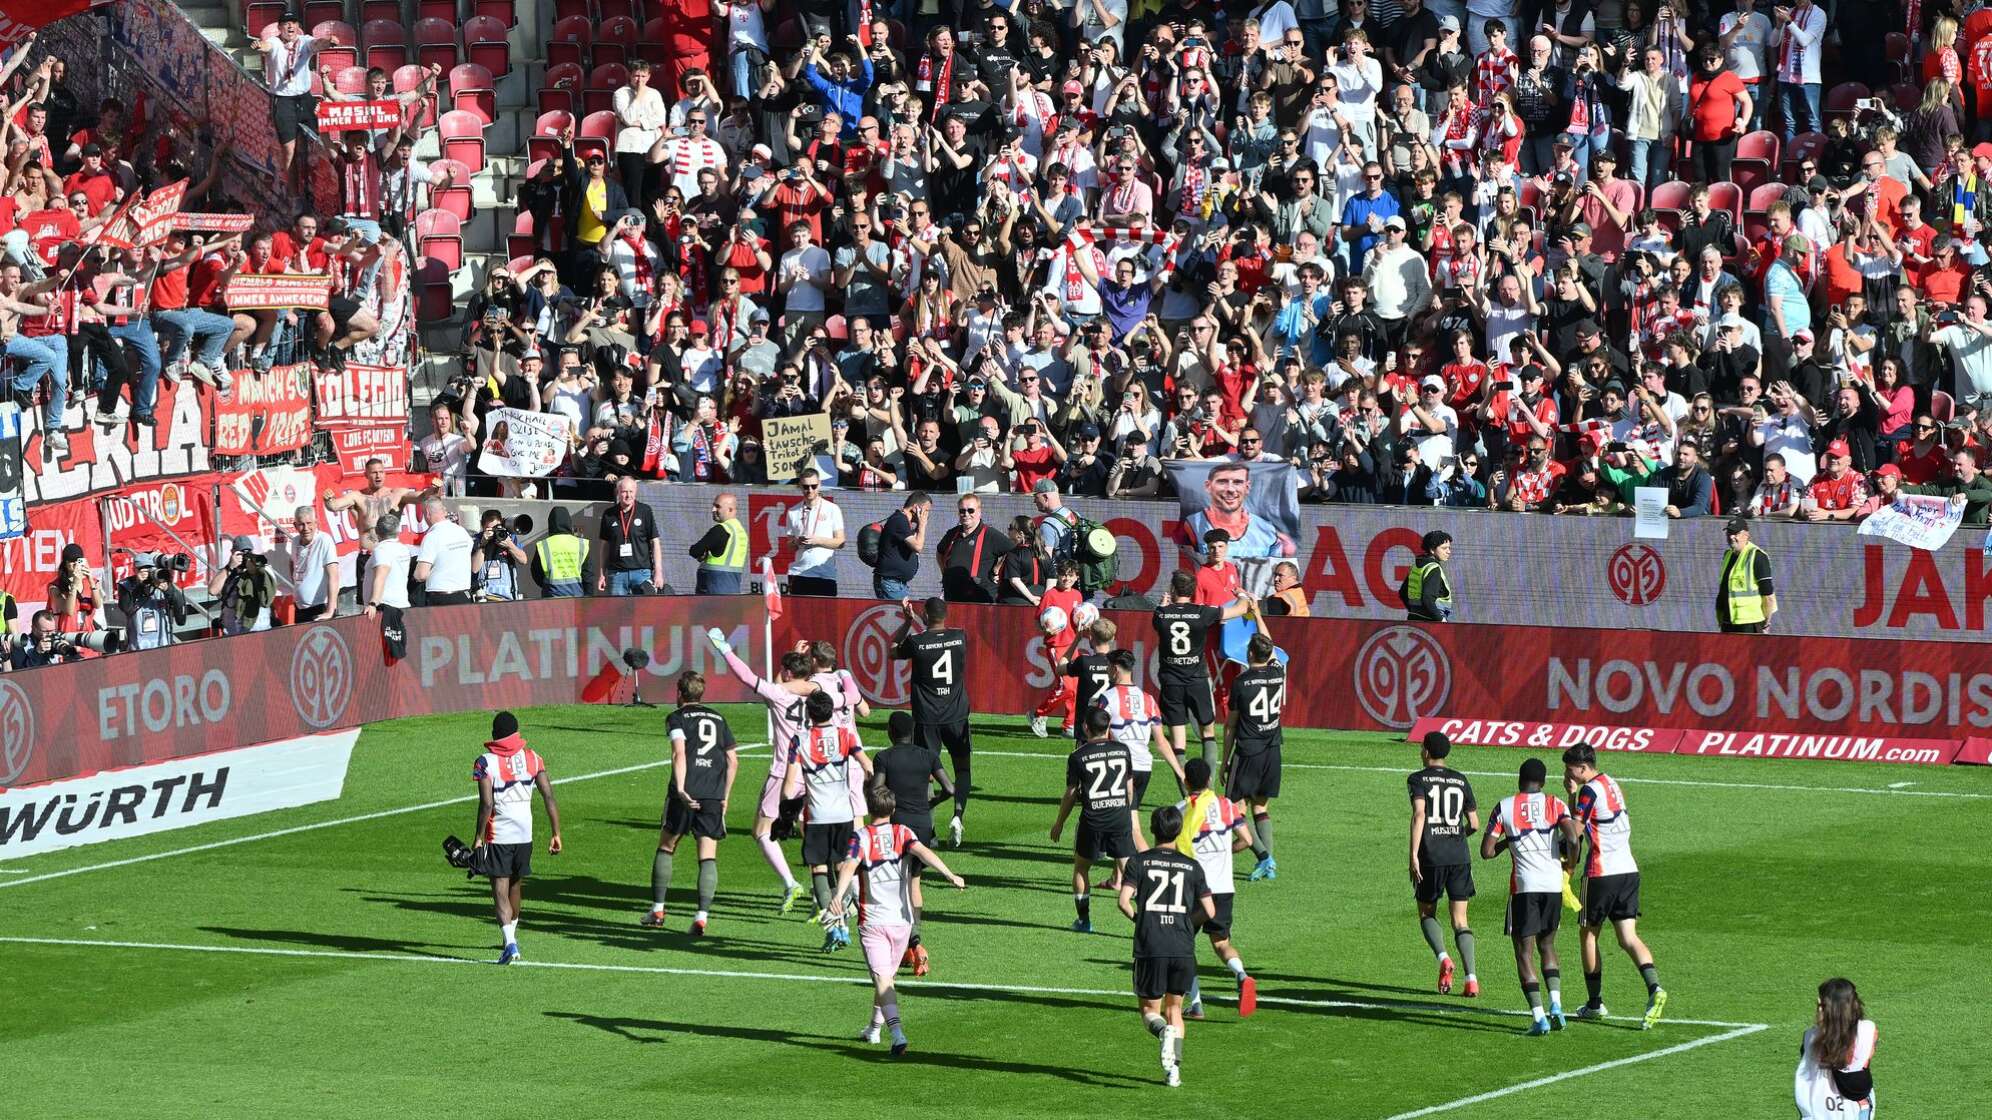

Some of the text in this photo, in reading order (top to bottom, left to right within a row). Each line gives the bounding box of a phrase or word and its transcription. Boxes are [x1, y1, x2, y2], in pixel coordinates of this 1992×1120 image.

[318, 116, 352, 127] IMMER
[377, 113, 398, 123] UNS
[230, 293, 267, 306] IMMER
[217, 413, 250, 450] RED
[769, 449, 800, 461] Trikot
[420, 623, 751, 688] PLATINUM
[1170, 621, 1191, 656] 8
[932, 649, 953, 685] 4
[98, 668, 232, 741] ETORO
[936, 686, 951, 696] TAH
[1249, 683, 1283, 723] 44
[1547, 656, 1736, 718] NOVO
[697, 718, 717, 756] 9
[1439, 719, 1655, 751] CATS & DOGS
[1697, 731, 1941, 764] PLATINUM.com
[1085, 758, 1127, 800] 22
[0, 766, 230, 846] WÜRTH
[1427, 784, 1465, 827] 10
[1145, 869, 1188, 914] 21
[1160, 914, 1175, 925] ITO
[1825, 1096, 1845, 1112] 02
